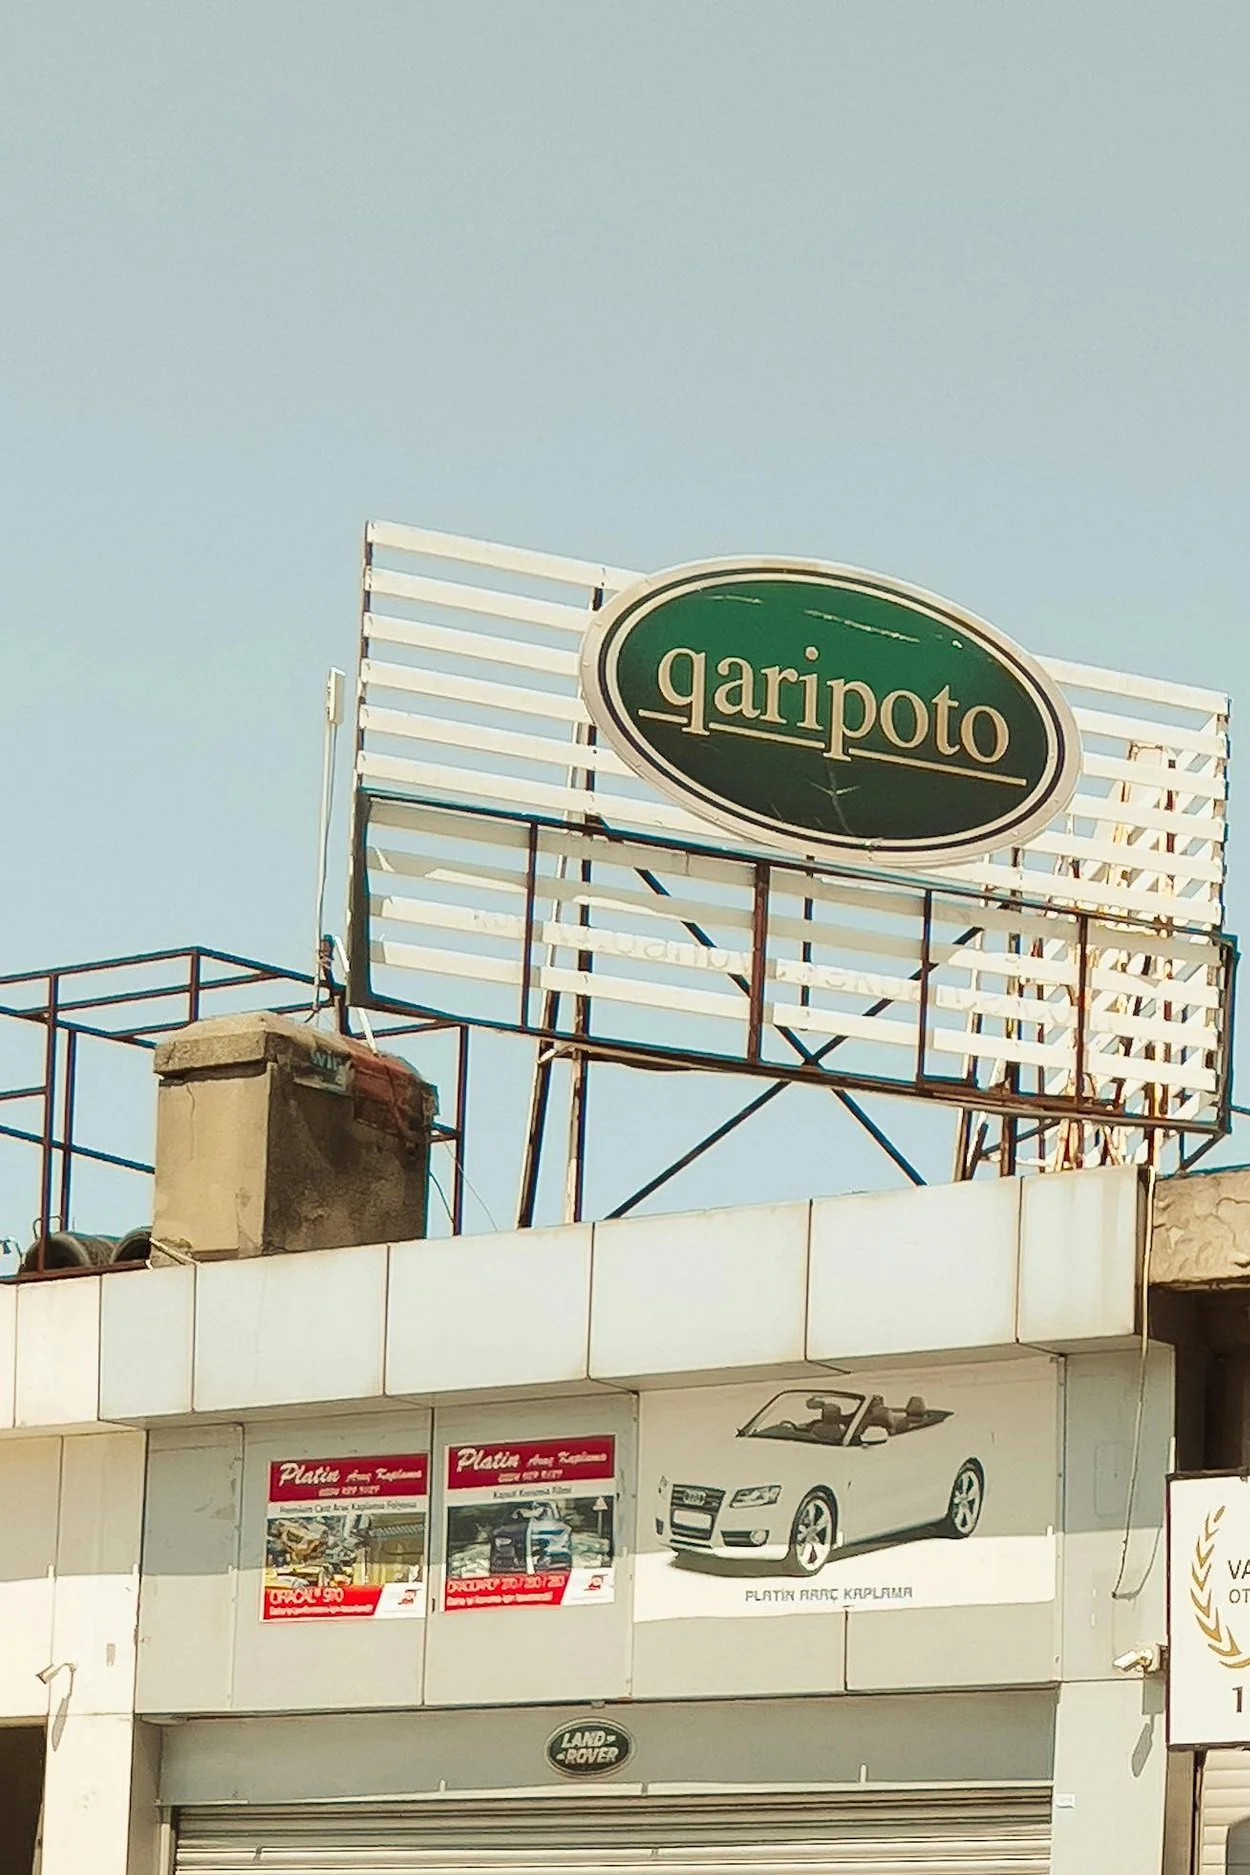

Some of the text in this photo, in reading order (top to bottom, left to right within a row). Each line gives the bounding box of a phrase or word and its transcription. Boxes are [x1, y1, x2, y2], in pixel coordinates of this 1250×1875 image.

[657, 646, 1011, 764] qaripoto
[457, 1447, 520, 1473] Platin
[278, 1462, 340, 1487] Platin
[561, 1730, 606, 1748] LAND
[565, 1746, 619, 1764] ROVER
